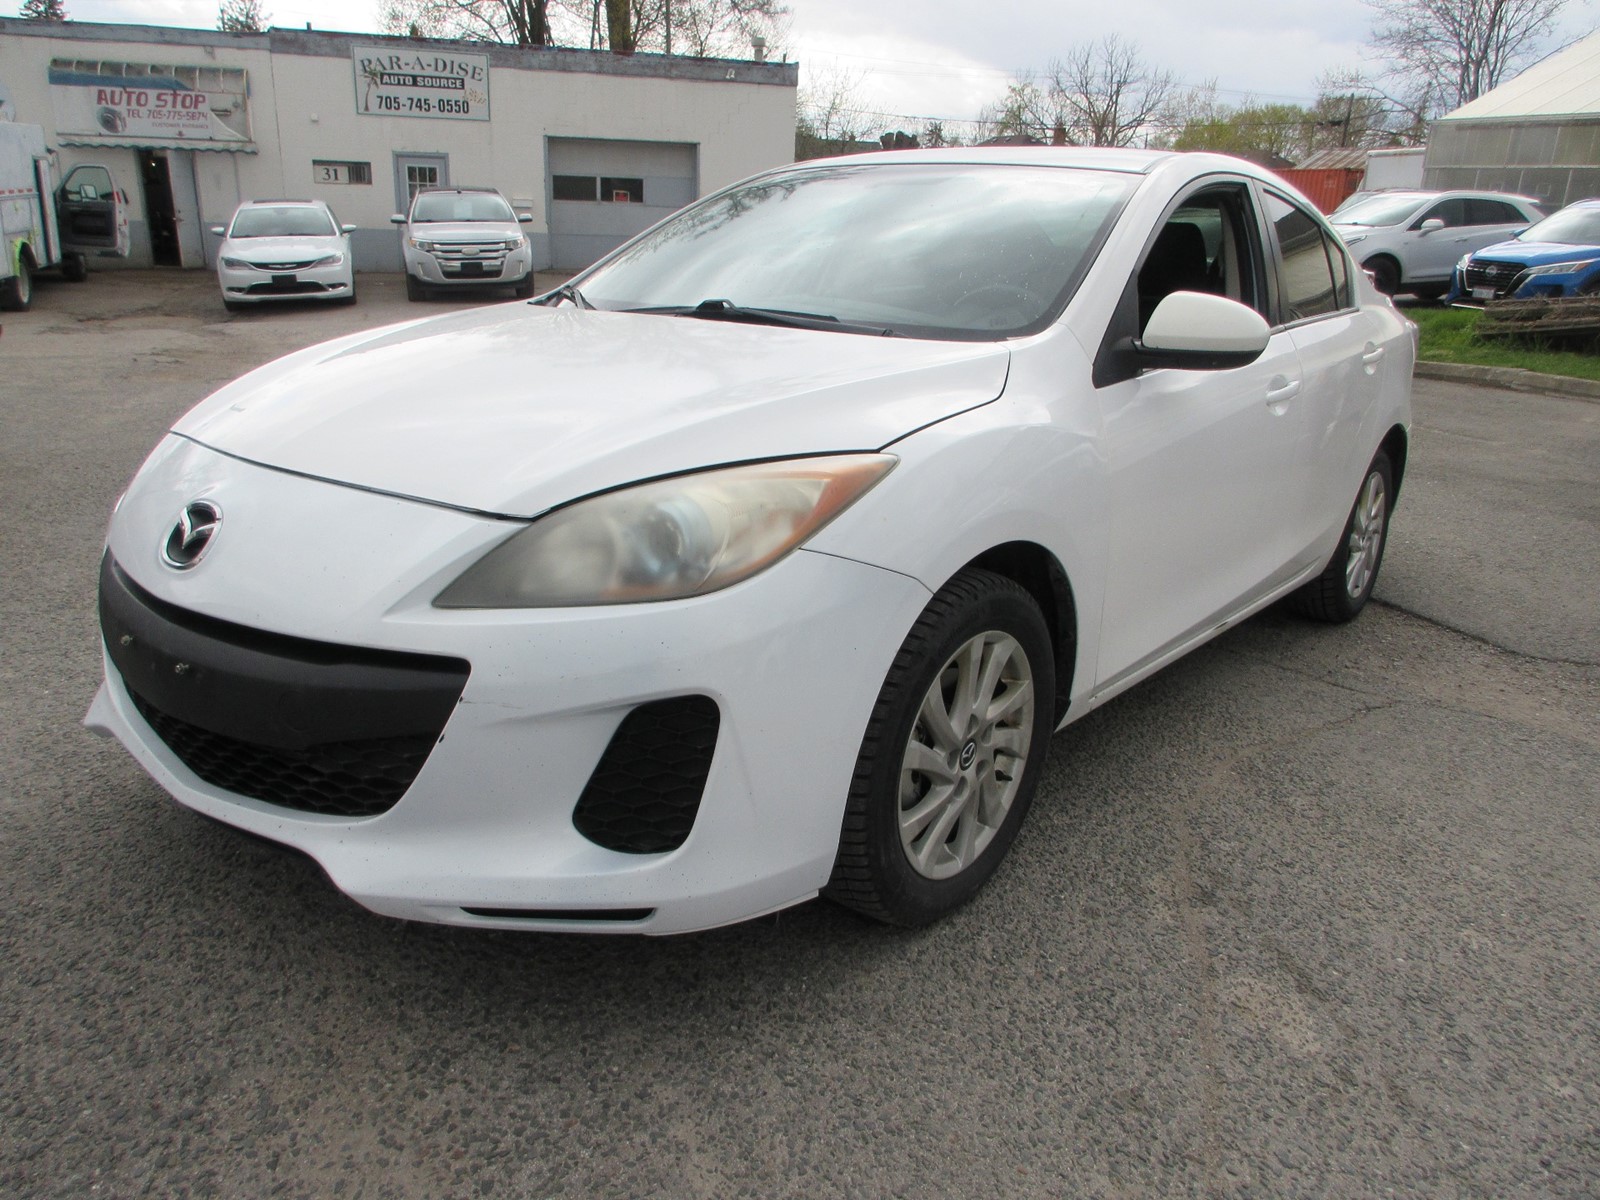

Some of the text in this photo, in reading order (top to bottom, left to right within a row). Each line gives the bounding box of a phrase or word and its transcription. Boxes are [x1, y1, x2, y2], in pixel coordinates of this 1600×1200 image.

[360, 55, 483, 82] PAR-A-DISE
[382, 74, 463, 89] AUTO SOURCE
[96, 89, 206, 110] AUTO STOP
[376, 95, 469, 114] 705-745-0550
[322, 167, 340, 182] 31
